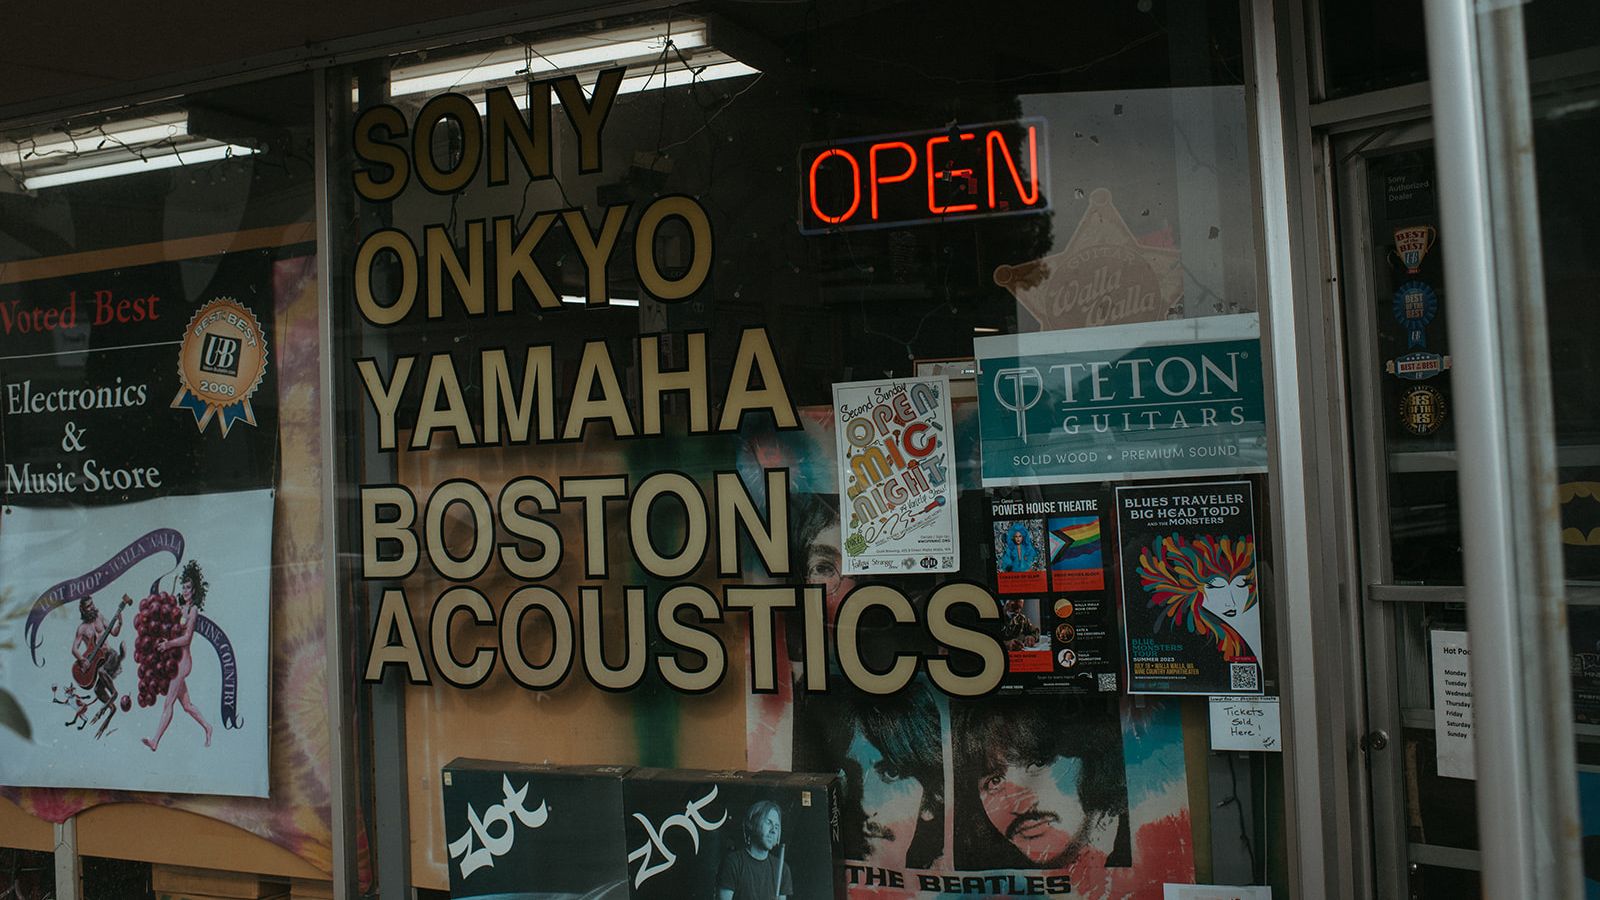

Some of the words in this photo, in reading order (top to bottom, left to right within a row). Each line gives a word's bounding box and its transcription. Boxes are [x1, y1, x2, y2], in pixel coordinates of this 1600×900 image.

[352, 66, 626, 200] SONY
[808, 124, 1039, 225] OPEN
[1388, 176, 1406, 186] Sony
[1388, 181, 1430, 193] Authorized
[1388, 193, 1412, 202] Dealer
[1396, 230, 1425, 241] BEST
[1400, 242, 1424, 252] BEST
[353, 193, 715, 328] ONKYO
[1053, 266, 1122, 317] Walla
[1405, 292, 1424, 303] BEST
[0, 289, 77, 336] Voted
[94, 289, 160, 326] Best
[194, 309, 222, 337] BEST
[226, 312, 257, 348] BEST
[6, 376, 148, 415] Electronics
[199, 380, 236, 397] 2009
[353, 325, 804, 453] YAMAHA
[840, 396, 874, 423] Second
[873, 382, 908, 407] Sunday
[846, 382, 939, 449] OPEN
[1063, 406, 1245, 435] GUITARS
[61, 421, 87, 452] &
[847, 421, 938, 500] MIC
[1012, 454, 1052, 466] SOLID
[1055, 451, 1098, 464] WOOD
[1121, 448, 1185, 462] PREMIUM
[1188, 444, 1238, 459] SOUND
[4, 463, 77, 494] Music
[82, 458, 162, 492] Store
[852, 454, 947, 525] NIGHT
[1125, 496, 1168, 508] BLUES
[1172, 494, 1244, 506] TRAVELER
[992, 504, 1024, 516] POWER
[1026, 502, 1056, 514] HOUSE
[1057, 499, 1098, 512] THEATRE
[1130, 510, 1154, 520] BIG
[1158, 507, 1197, 518] HEAD
[1201, 506, 1240, 517] TODD
[359, 467, 790, 582] BOSTON
[1169, 516, 1224, 526] MONSTERS
[69, 571, 103, 597] POOP
[109, 543, 146, 573] WALLA
[363, 579, 1006, 697] ACOUSTICS
[1444, 647, 1456, 655] Hot
[219, 642, 236, 709] COUNTRY
[1444, 669, 1466, 678] Monday
[1445, 680, 1468, 688] Tuesday
[1224, 704, 1264, 717] Tickets
[1446, 700, 1470, 708] Thursday
[1231, 718, 1254, 726] Sold
[1446, 720, 1471, 729] Saturday
[1447, 730, 1468, 738] Sunday
[846, 866, 904, 889] THE
[917, 873, 1071, 896] BEATLES
